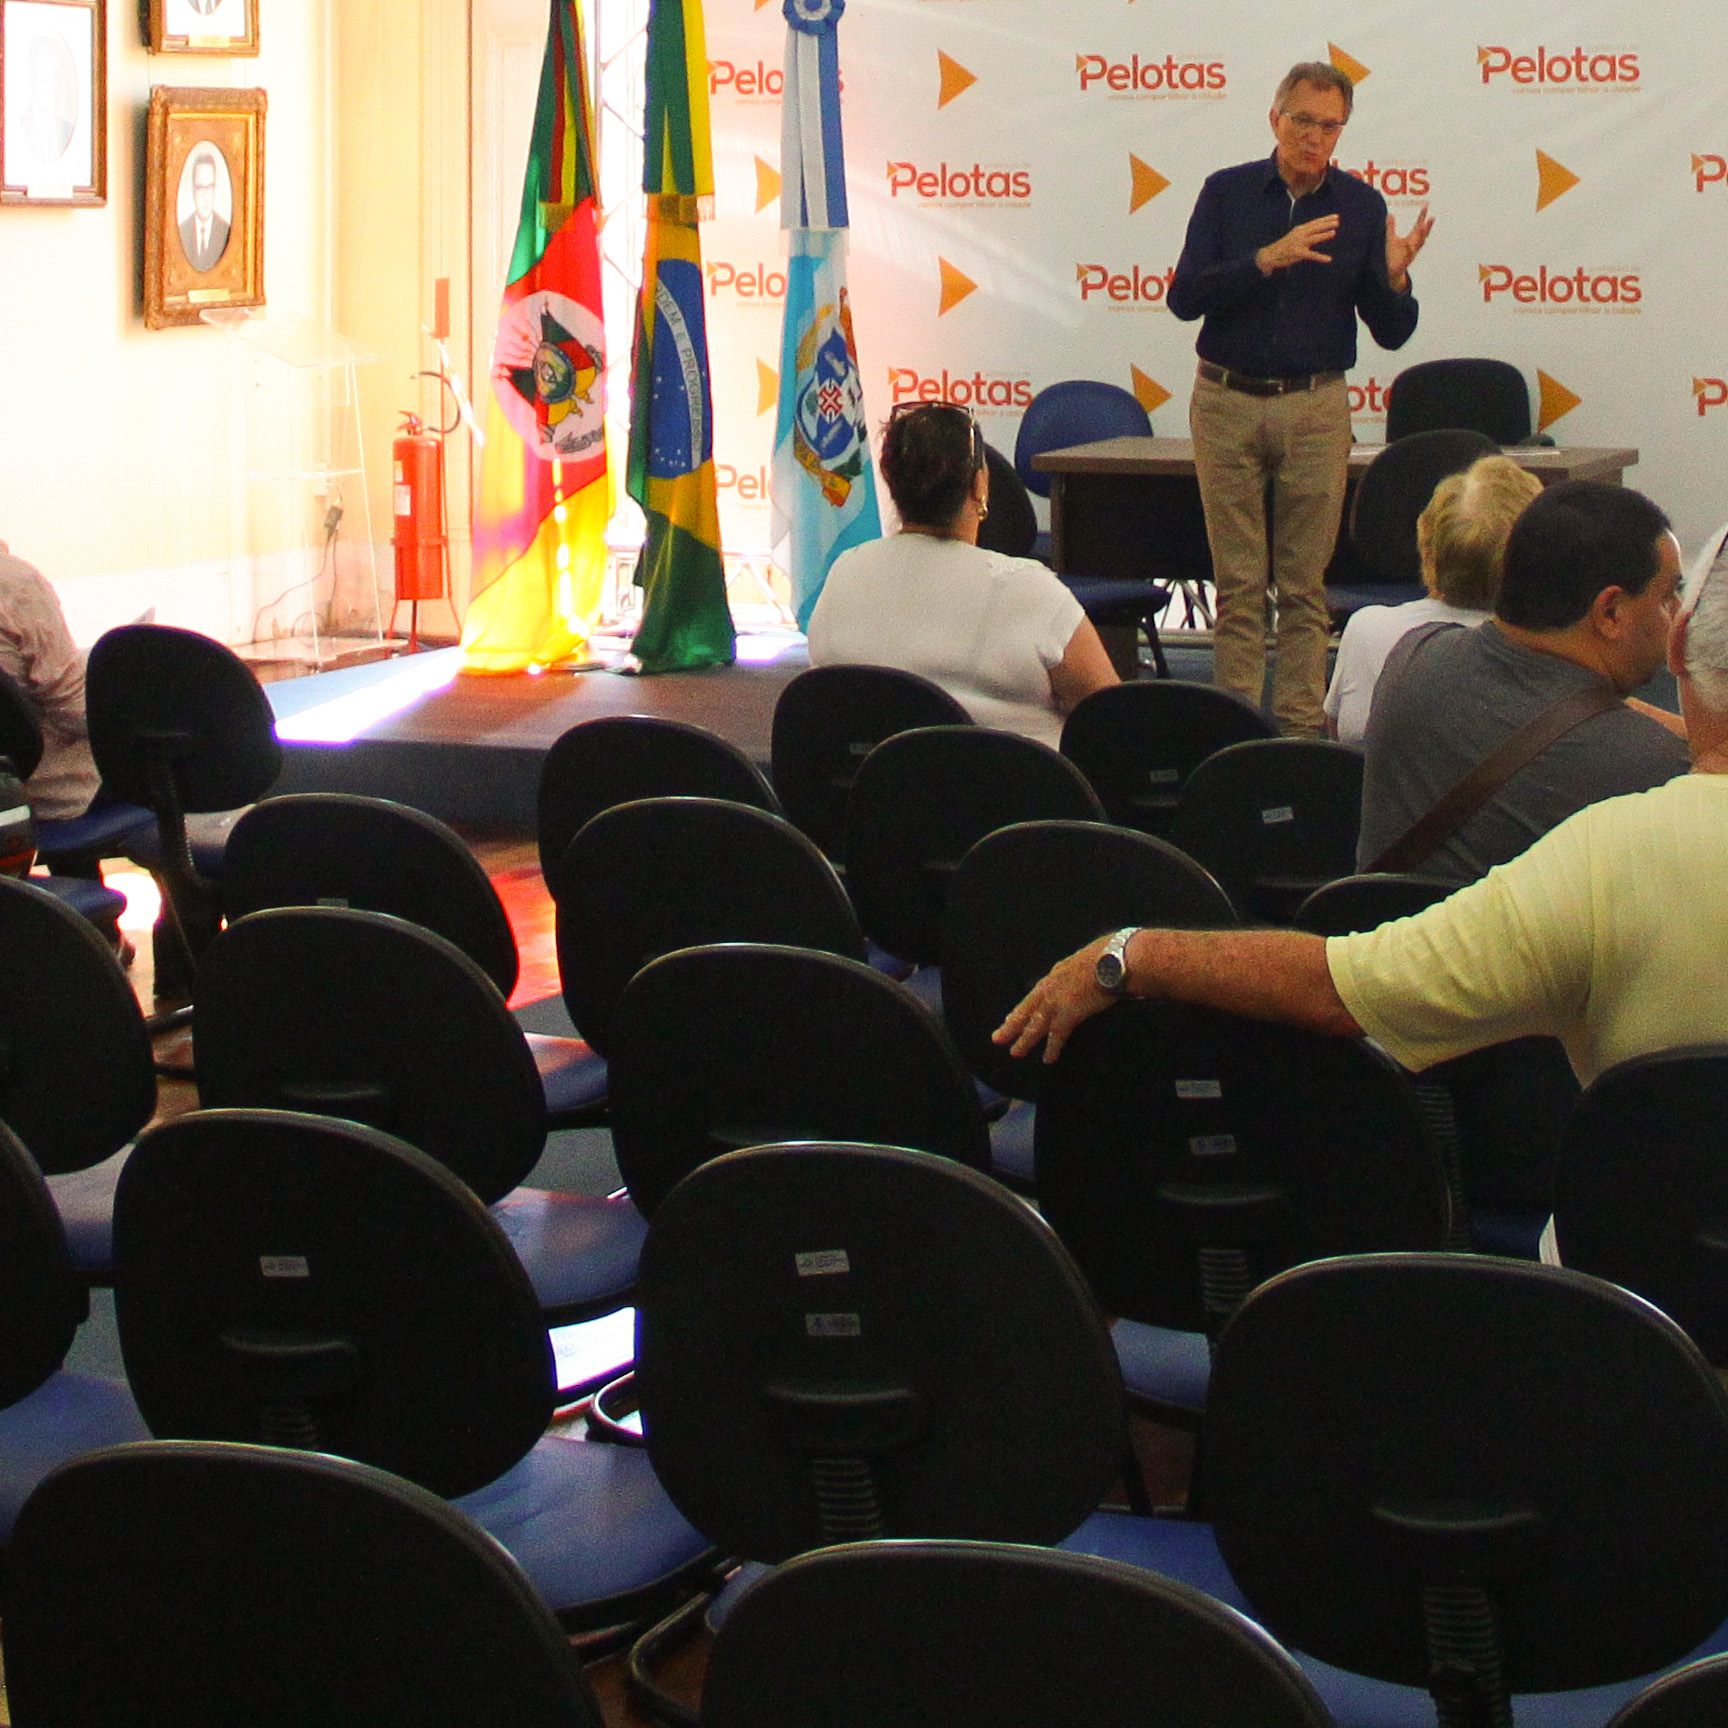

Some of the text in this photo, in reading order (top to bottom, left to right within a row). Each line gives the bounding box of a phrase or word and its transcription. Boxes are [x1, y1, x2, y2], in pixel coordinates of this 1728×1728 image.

[1076, 54, 1227, 92] Pelotas
[1477, 45, 1641, 85] Pelotas
[885, 160, 1033, 200] Pelotas
[707, 262, 786, 297] Pelo
[1478, 264, 1643, 305] Pelotas
[887, 366, 1033, 406] Pelotas
